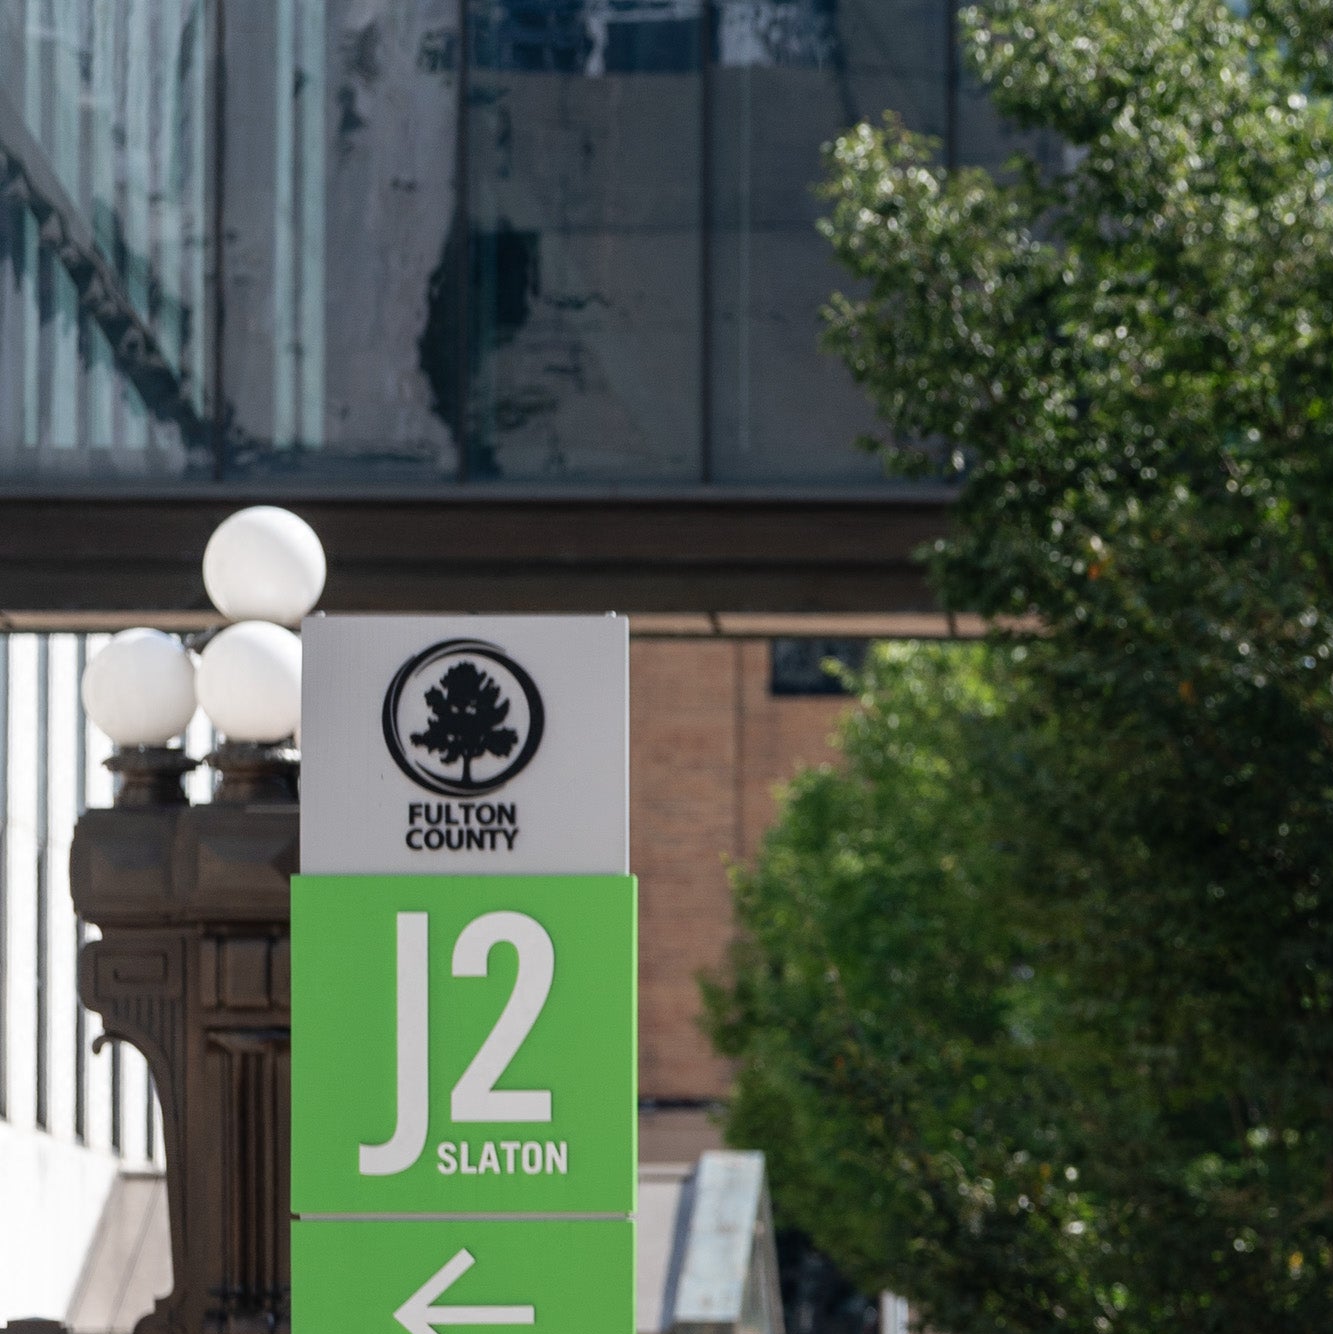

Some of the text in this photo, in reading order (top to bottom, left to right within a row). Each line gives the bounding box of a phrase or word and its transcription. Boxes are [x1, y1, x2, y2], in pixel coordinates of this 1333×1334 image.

[408, 802, 517, 827] FULTON
[405, 827, 519, 852] COUNTY
[358, 910, 556, 1176] J2
[436, 1140, 569, 1175] SLATON
